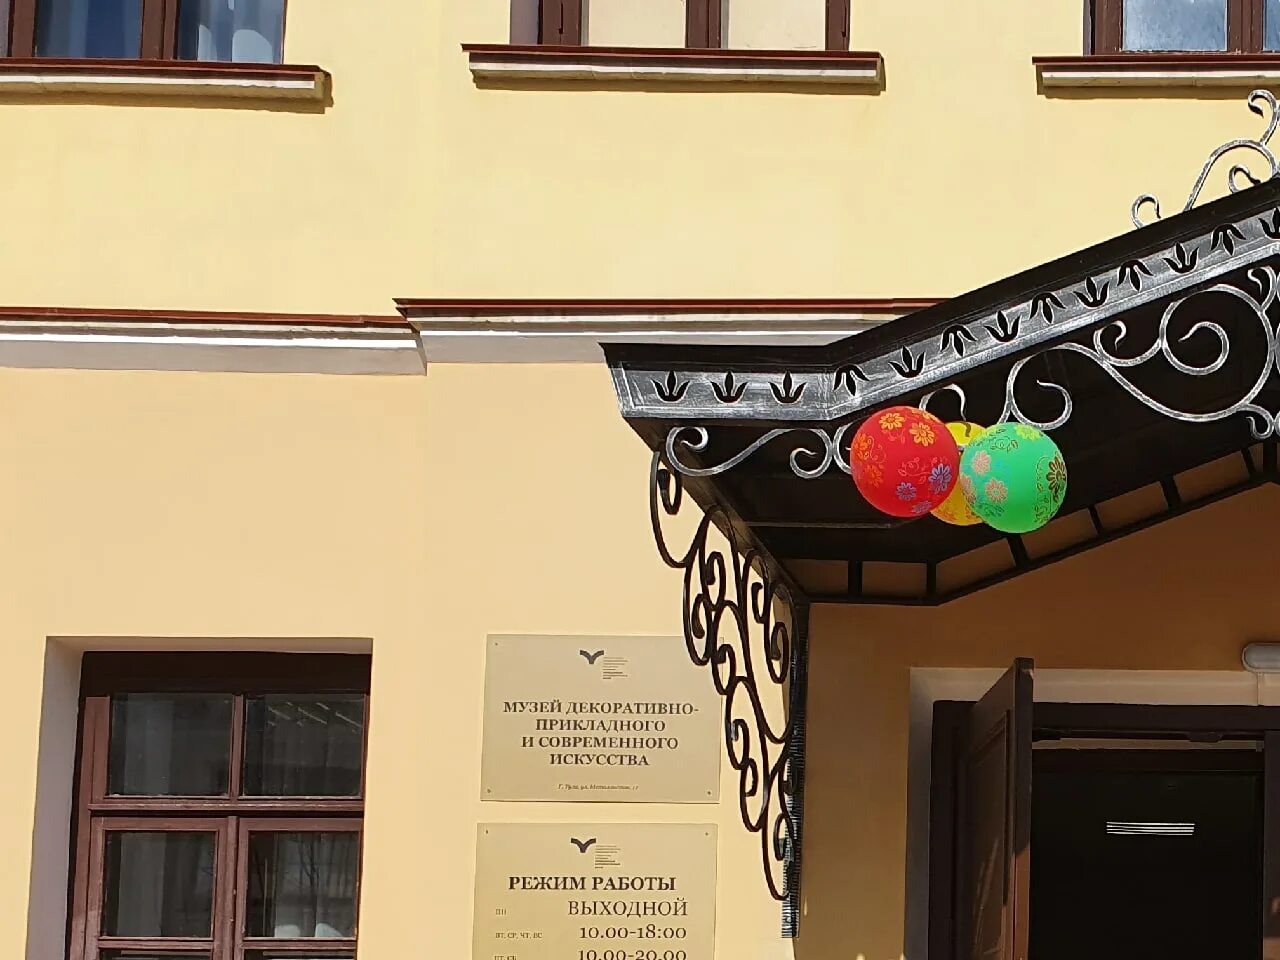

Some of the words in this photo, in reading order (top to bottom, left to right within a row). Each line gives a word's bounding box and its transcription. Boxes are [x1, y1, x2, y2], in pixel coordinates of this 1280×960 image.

[503, 699, 562, 713] МУЗЕЙ
[566, 701, 699, 715] ДЕКОРАТИВНО-
[535, 719, 666, 733] ПРИКЛАДНОГО
[521, 736, 534, 748] И
[538, 736, 679, 749] СОВРЕМЕННОГО
[550, 754, 649, 766] ИСКУССТВА
[508, 876, 586, 890] РЕЖИМ
[591, 876, 677, 891] РАБОТЫ
[495, 908, 507, 916] ПН
[567, 897, 688, 918] ВЫХОДНОЙ
[579, 924, 688, 940] 10.00-18:00
